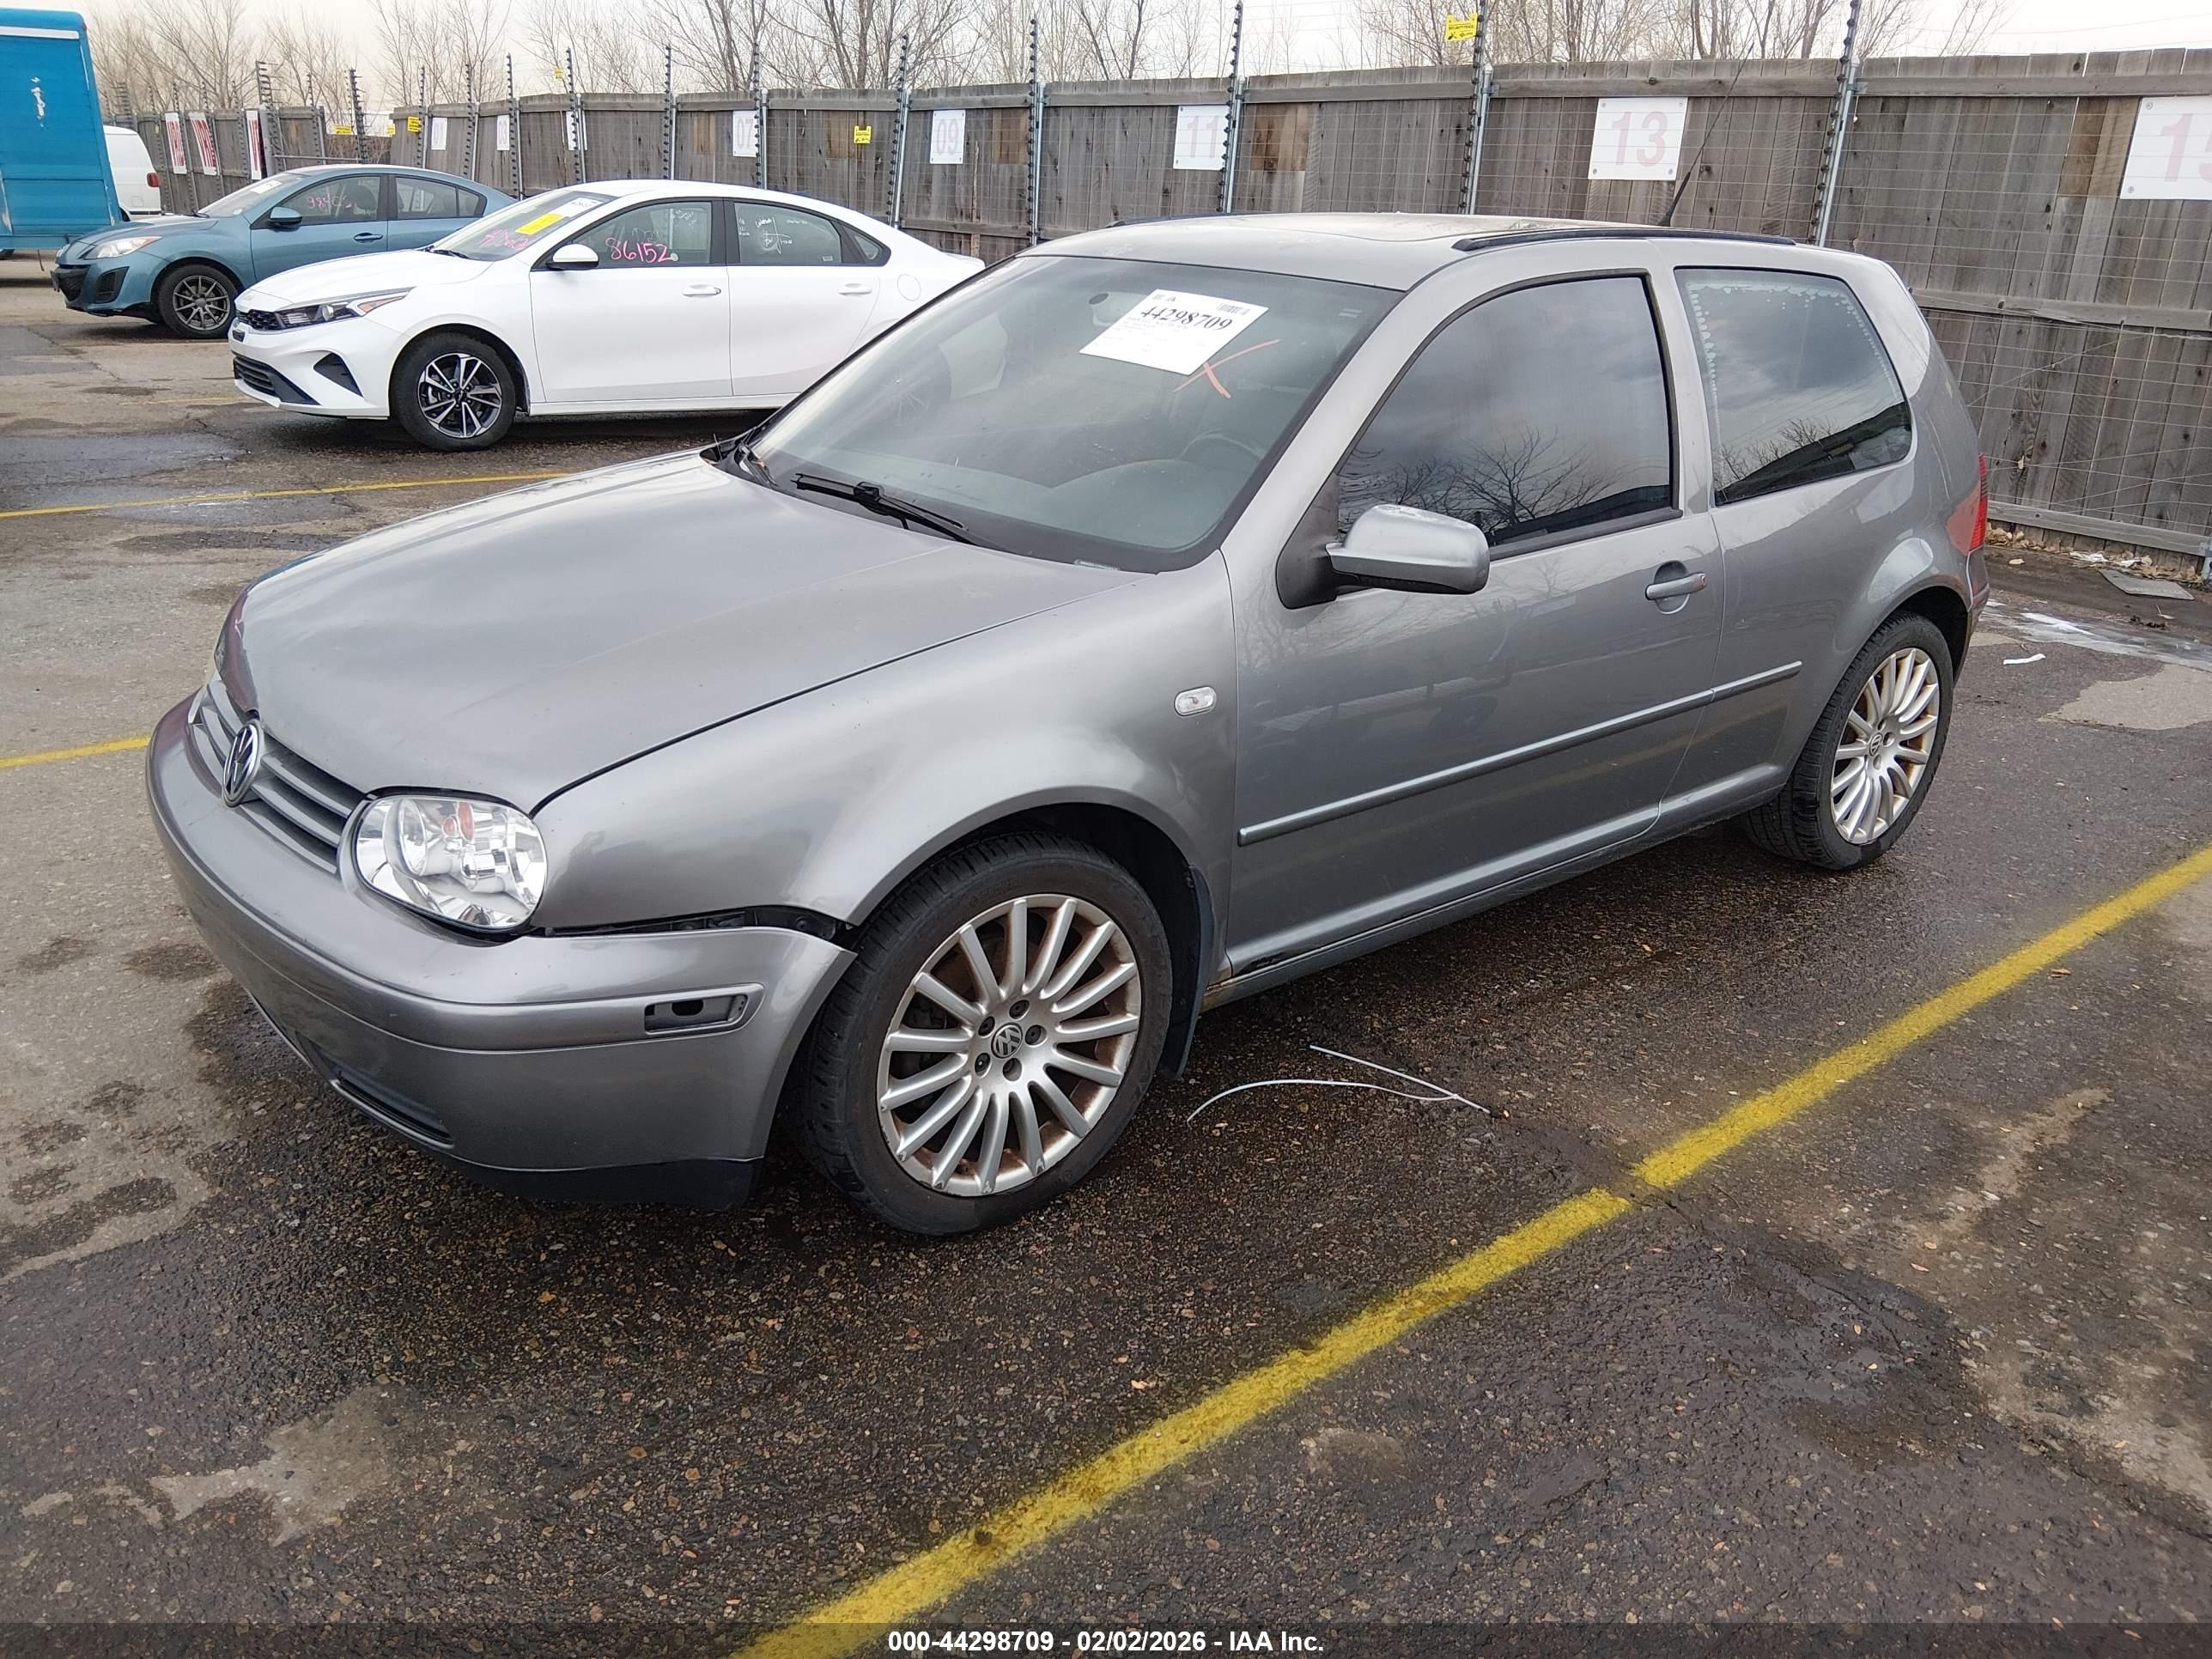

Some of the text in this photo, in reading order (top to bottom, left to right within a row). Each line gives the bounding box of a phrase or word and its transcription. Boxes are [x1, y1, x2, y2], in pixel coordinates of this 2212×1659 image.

[736, 118, 755, 149] 07
[936, 118, 959, 155] 09
[1187, 115, 1219, 158] 11
[1612, 111, 1668, 167] 13
[605, 236, 674, 264] 86152
[1140, 306, 1233, 331] 44298709
